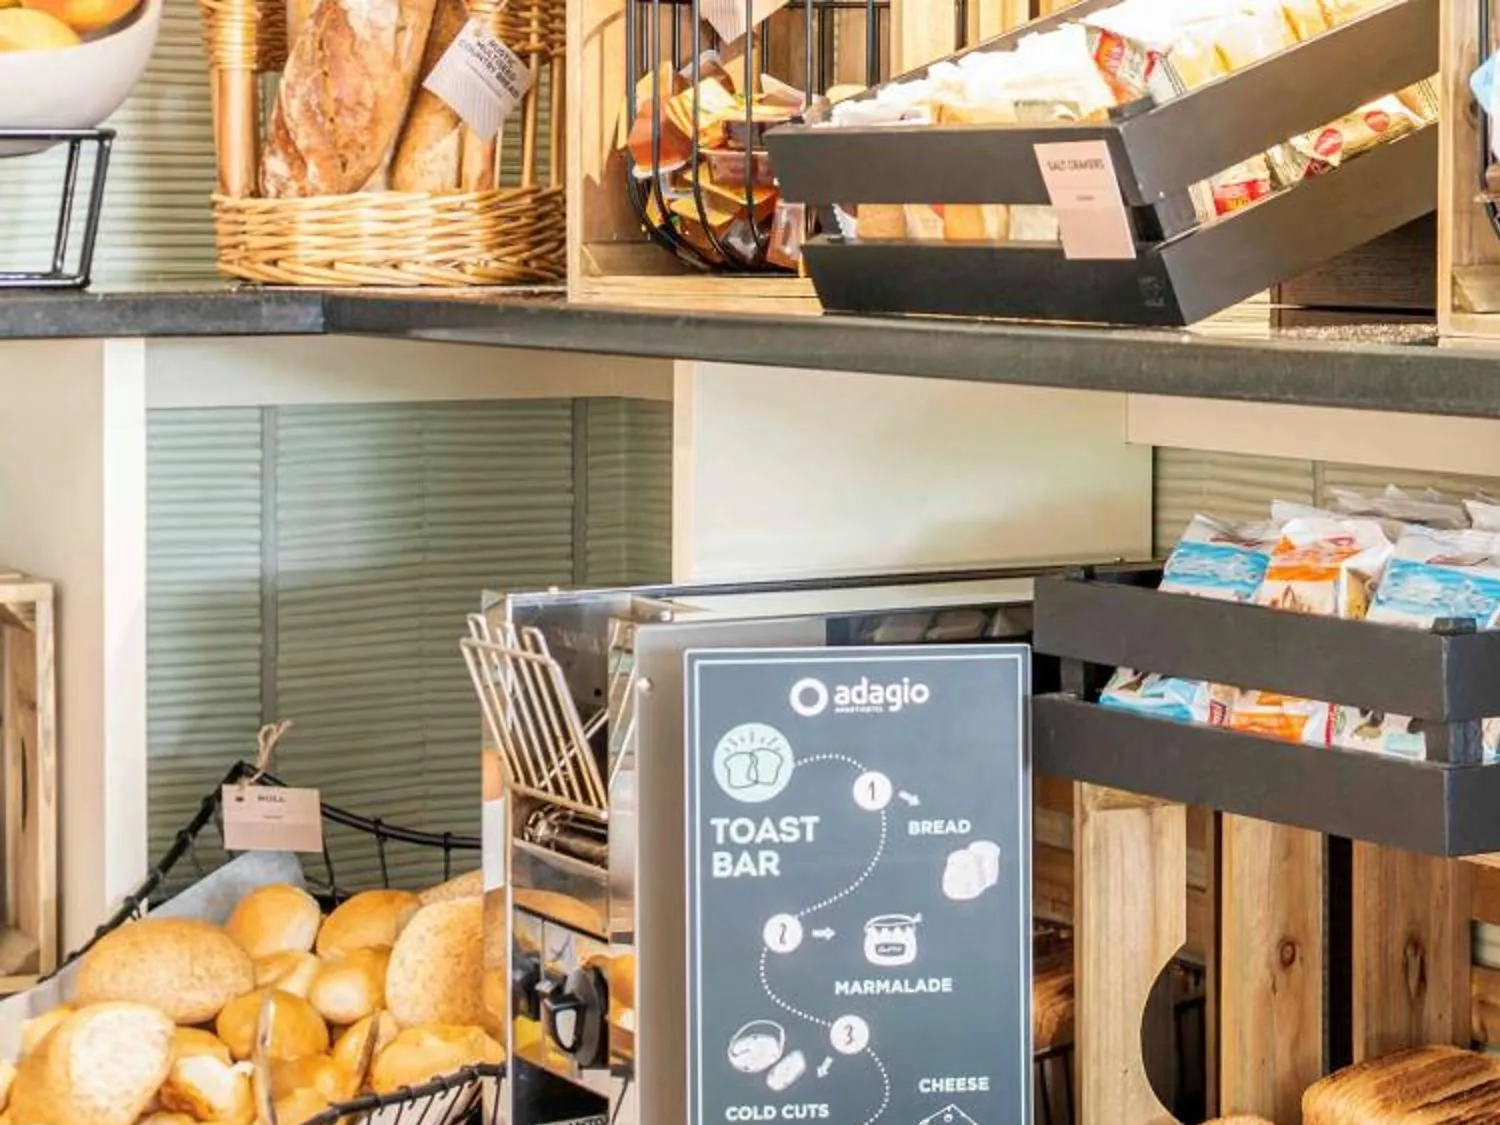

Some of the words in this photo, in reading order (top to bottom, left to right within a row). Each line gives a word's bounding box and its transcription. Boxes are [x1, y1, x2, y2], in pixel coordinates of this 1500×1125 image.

[833, 676, 929, 712] adagio
[710, 815, 819, 844] TOAST
[908, 819, 971, 835] BREAD
[712, 850, 780, 878] BAR
[834, 977, 953, 995] MARMALADE
[918, 1076, 990, 1093] CHEESE
[725, 1105, 777, 1121] COLD
[781, 1104, 829, 1119] CUTS
